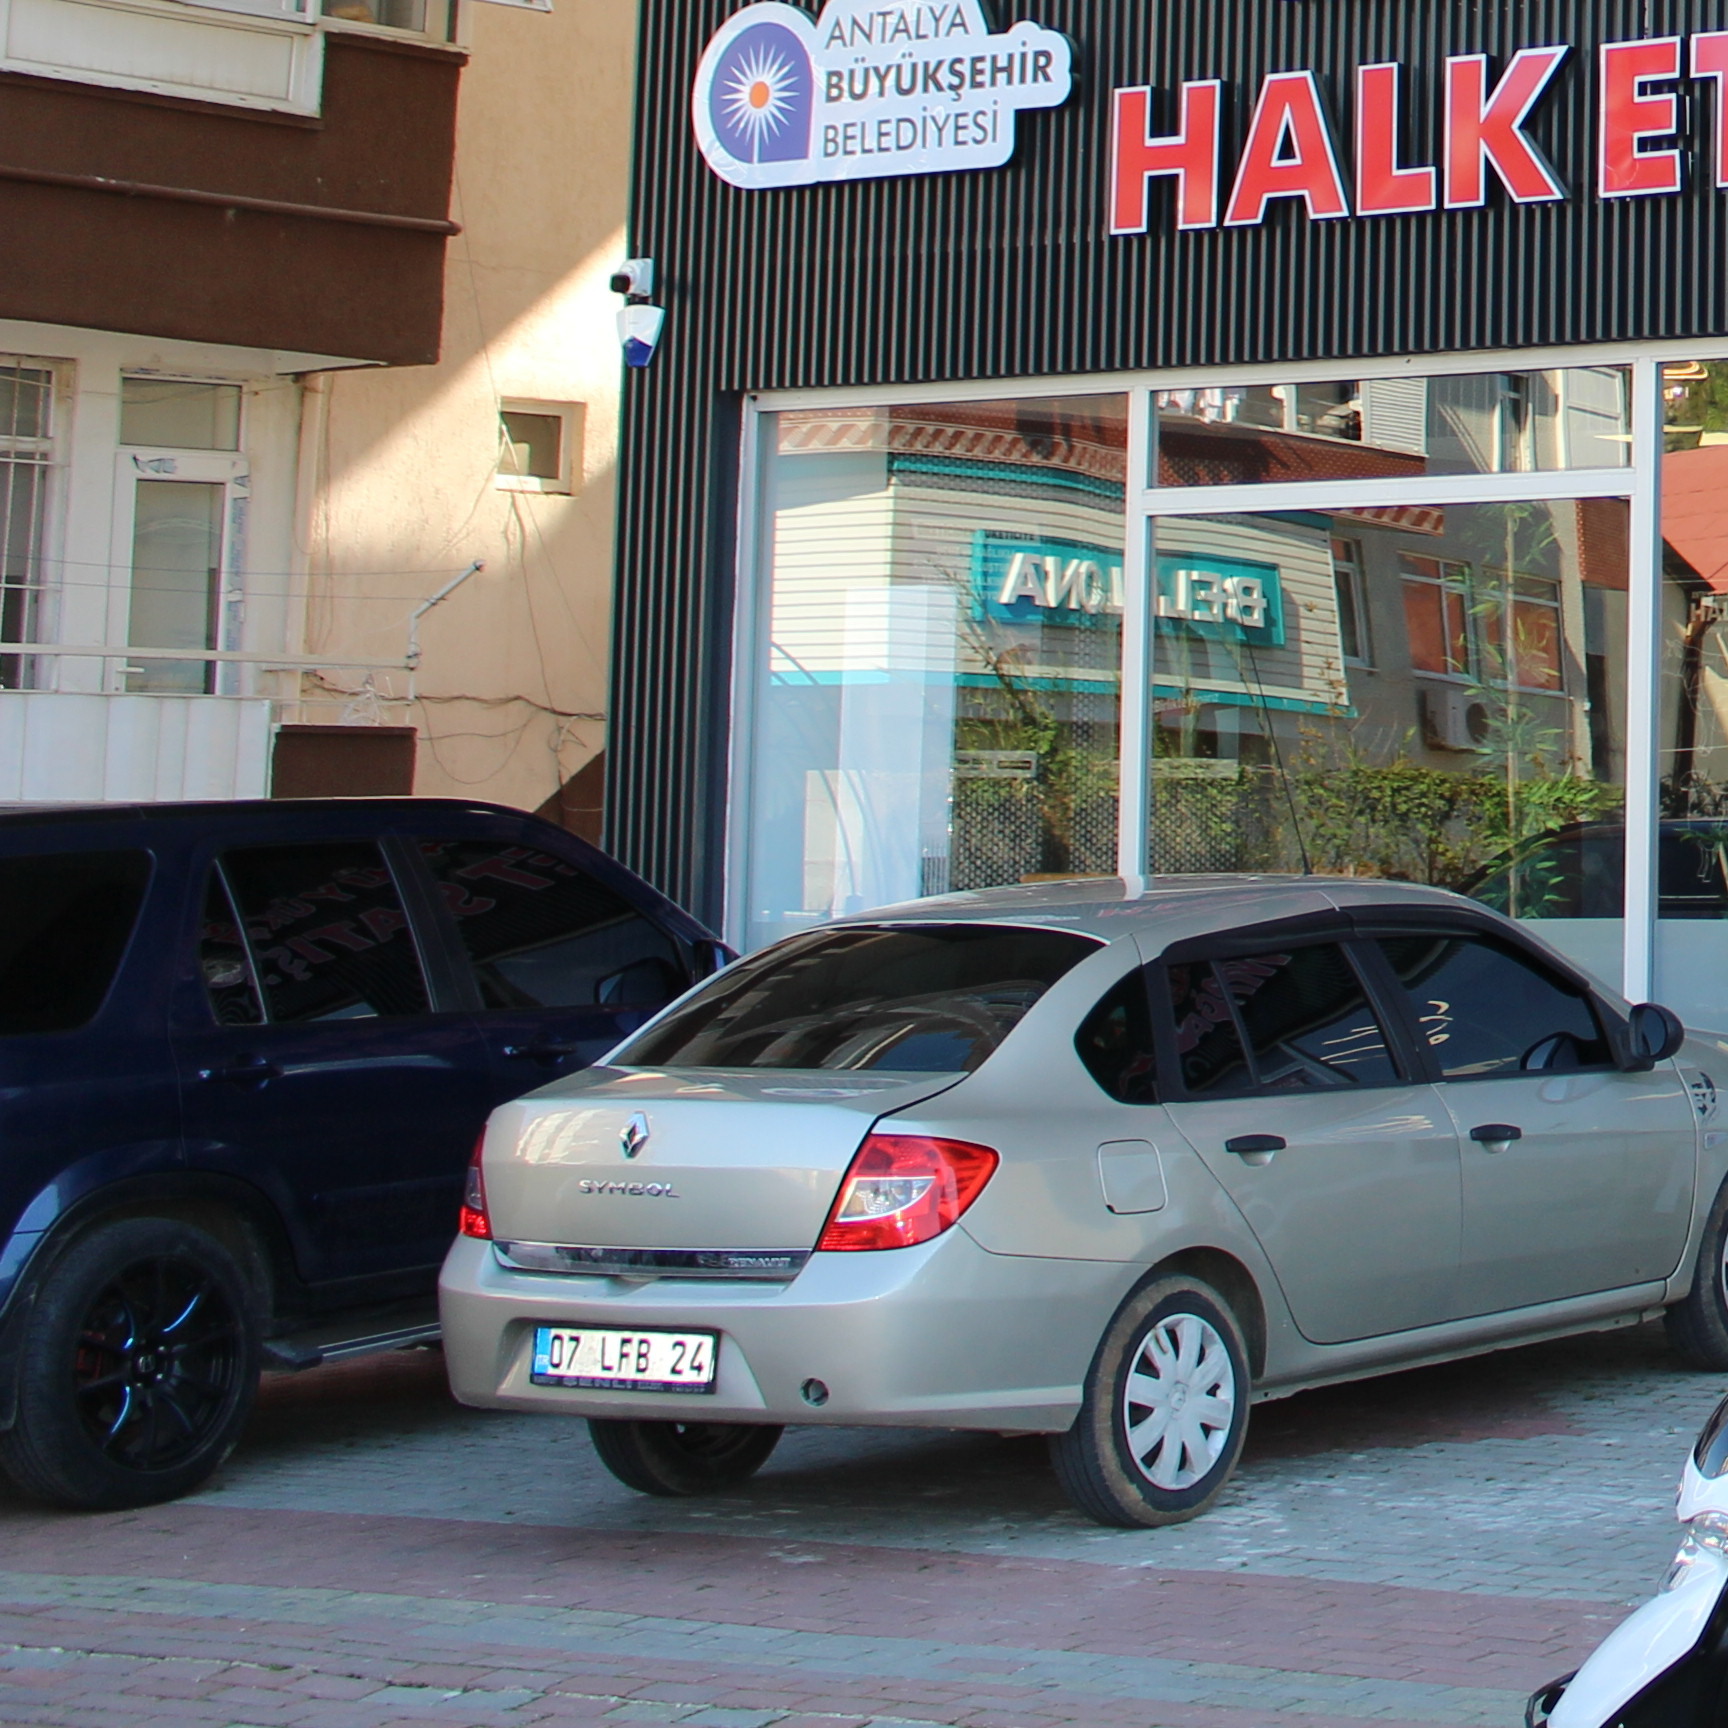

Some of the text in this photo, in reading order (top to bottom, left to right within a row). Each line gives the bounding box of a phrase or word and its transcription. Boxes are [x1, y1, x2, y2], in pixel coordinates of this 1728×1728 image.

[824, 3, 971, 51] ANTALYA
[825, 39, 1052, 104] BÜYÜKŞEHİR
[823, 99, 998, 158] BELEDİYESİ
[1109, 43, 1573, 235] HALK
[578, 1179, 681, 1198] SYMBOL
[550, 1334, 581, 1370] 07
[601, 1336, 652, 1374] LFB
[669, 1340, 704, 1376] 24
